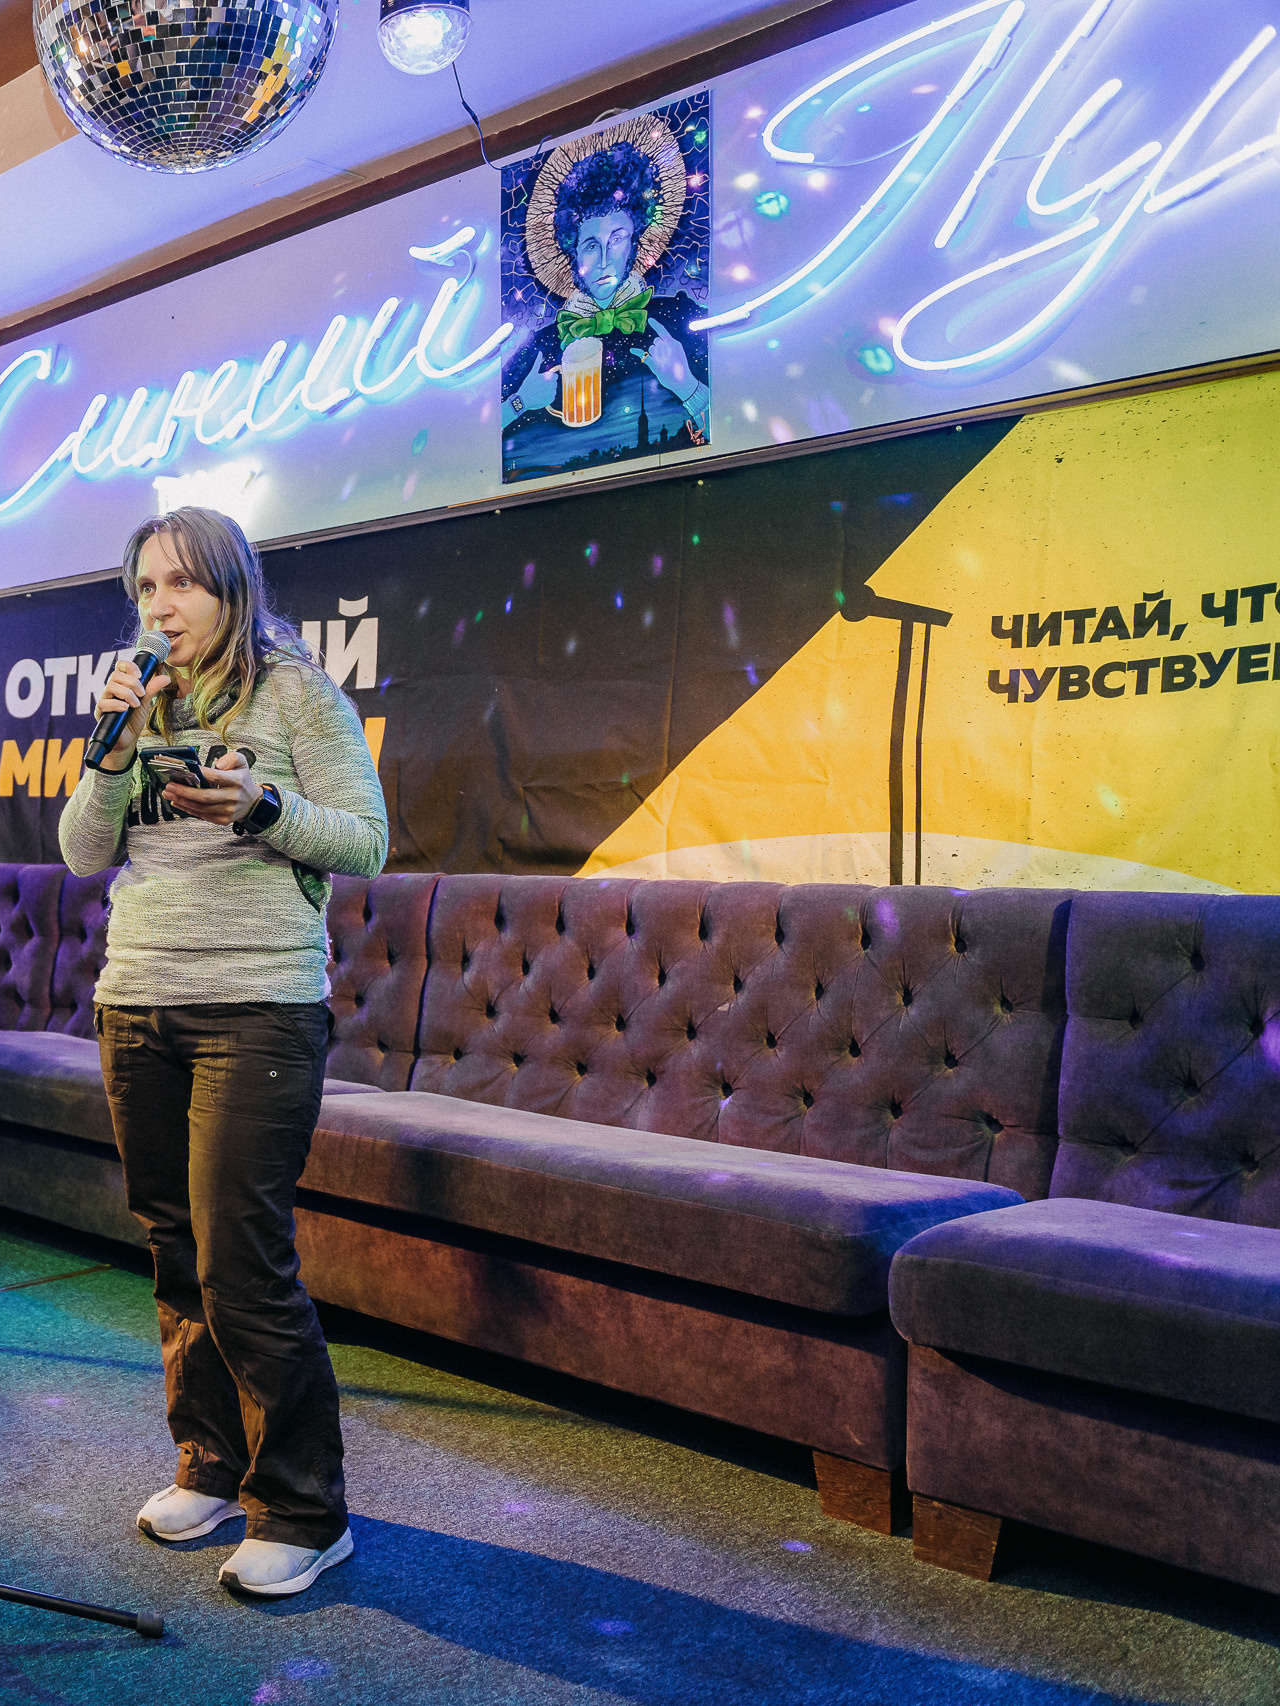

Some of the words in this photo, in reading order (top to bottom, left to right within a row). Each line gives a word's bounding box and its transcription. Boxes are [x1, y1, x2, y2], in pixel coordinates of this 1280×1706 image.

[689, 0, 1280, 371] Пу
[990, 588, 1189, 649] ЧИТАЙ,
[1200, 581, 1280, 628] ЧТ
[986, 641, 1280, 704] ЧУВСТВУЕ
